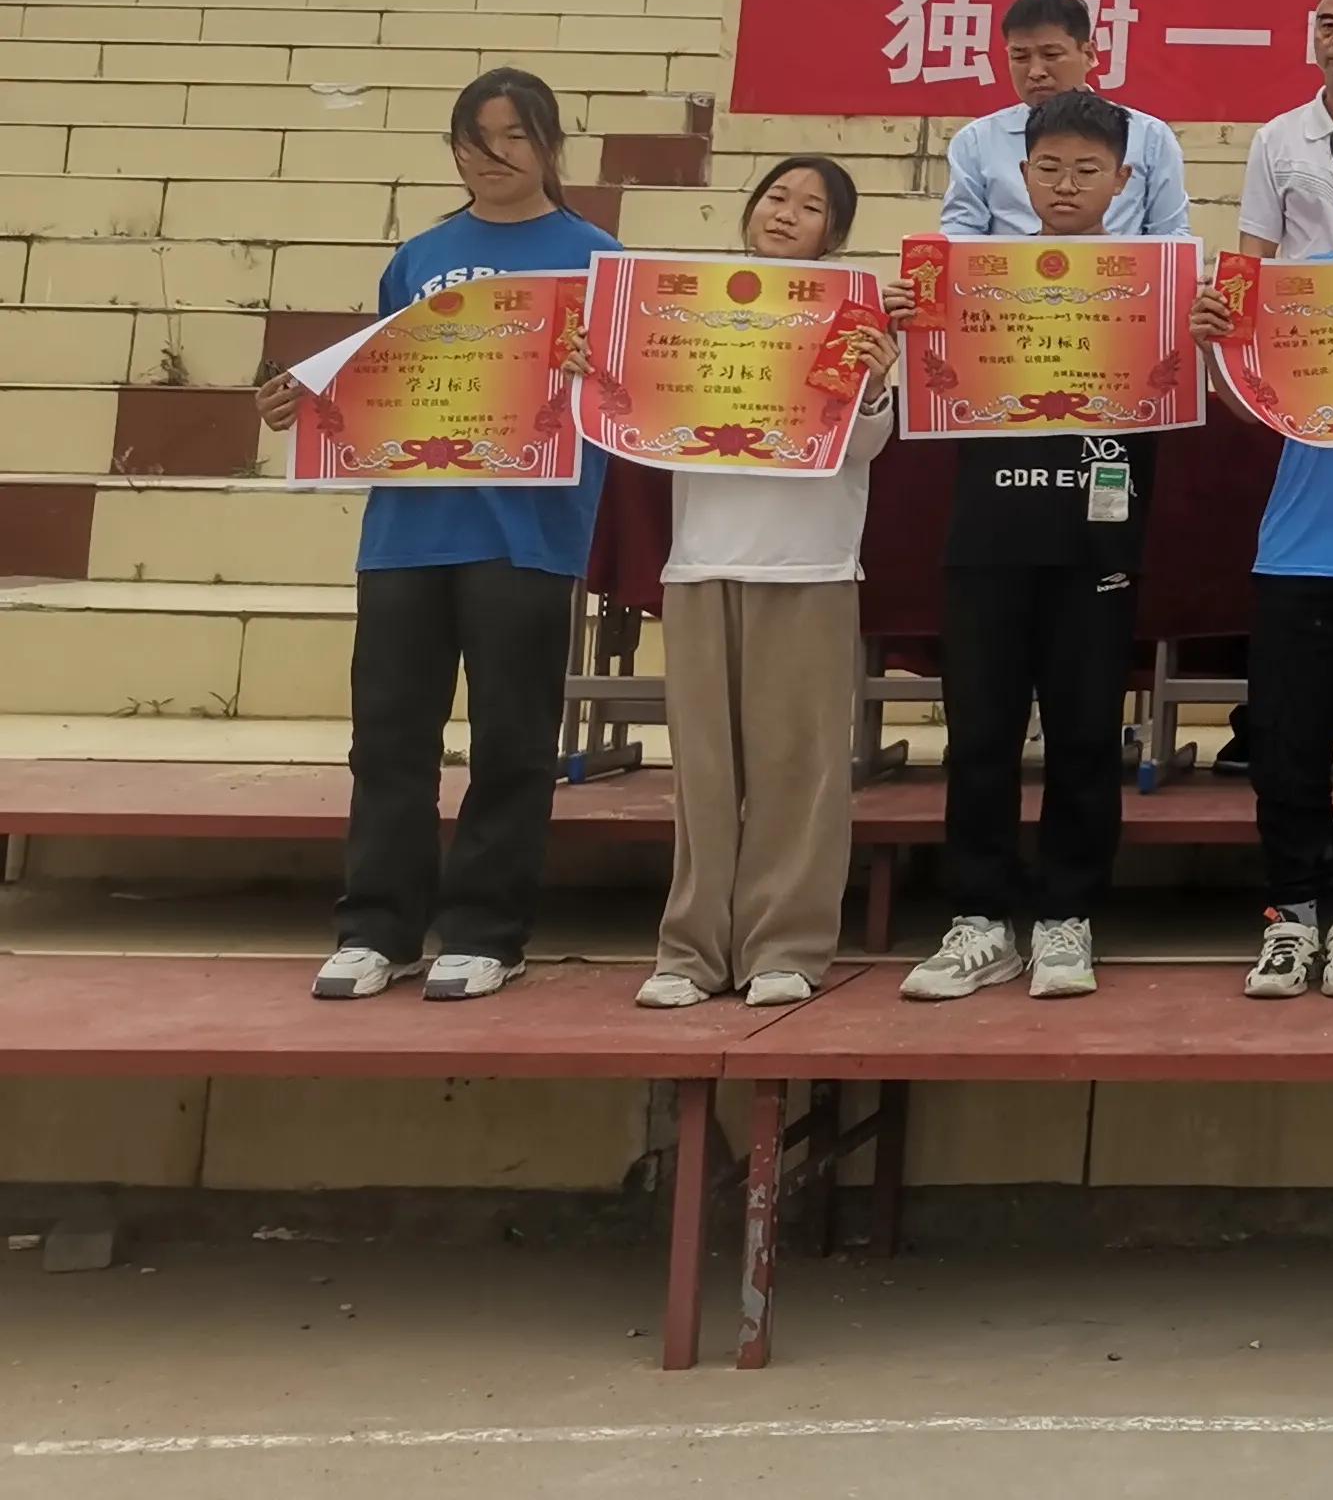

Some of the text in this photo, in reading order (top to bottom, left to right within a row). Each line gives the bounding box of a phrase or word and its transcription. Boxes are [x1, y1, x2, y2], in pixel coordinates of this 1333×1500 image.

[1017, 336, 1090, 351] 学习标兵
[698, 364, 772, 381] 学习标兵
[406, 377, 481, 392] 学习标兵
